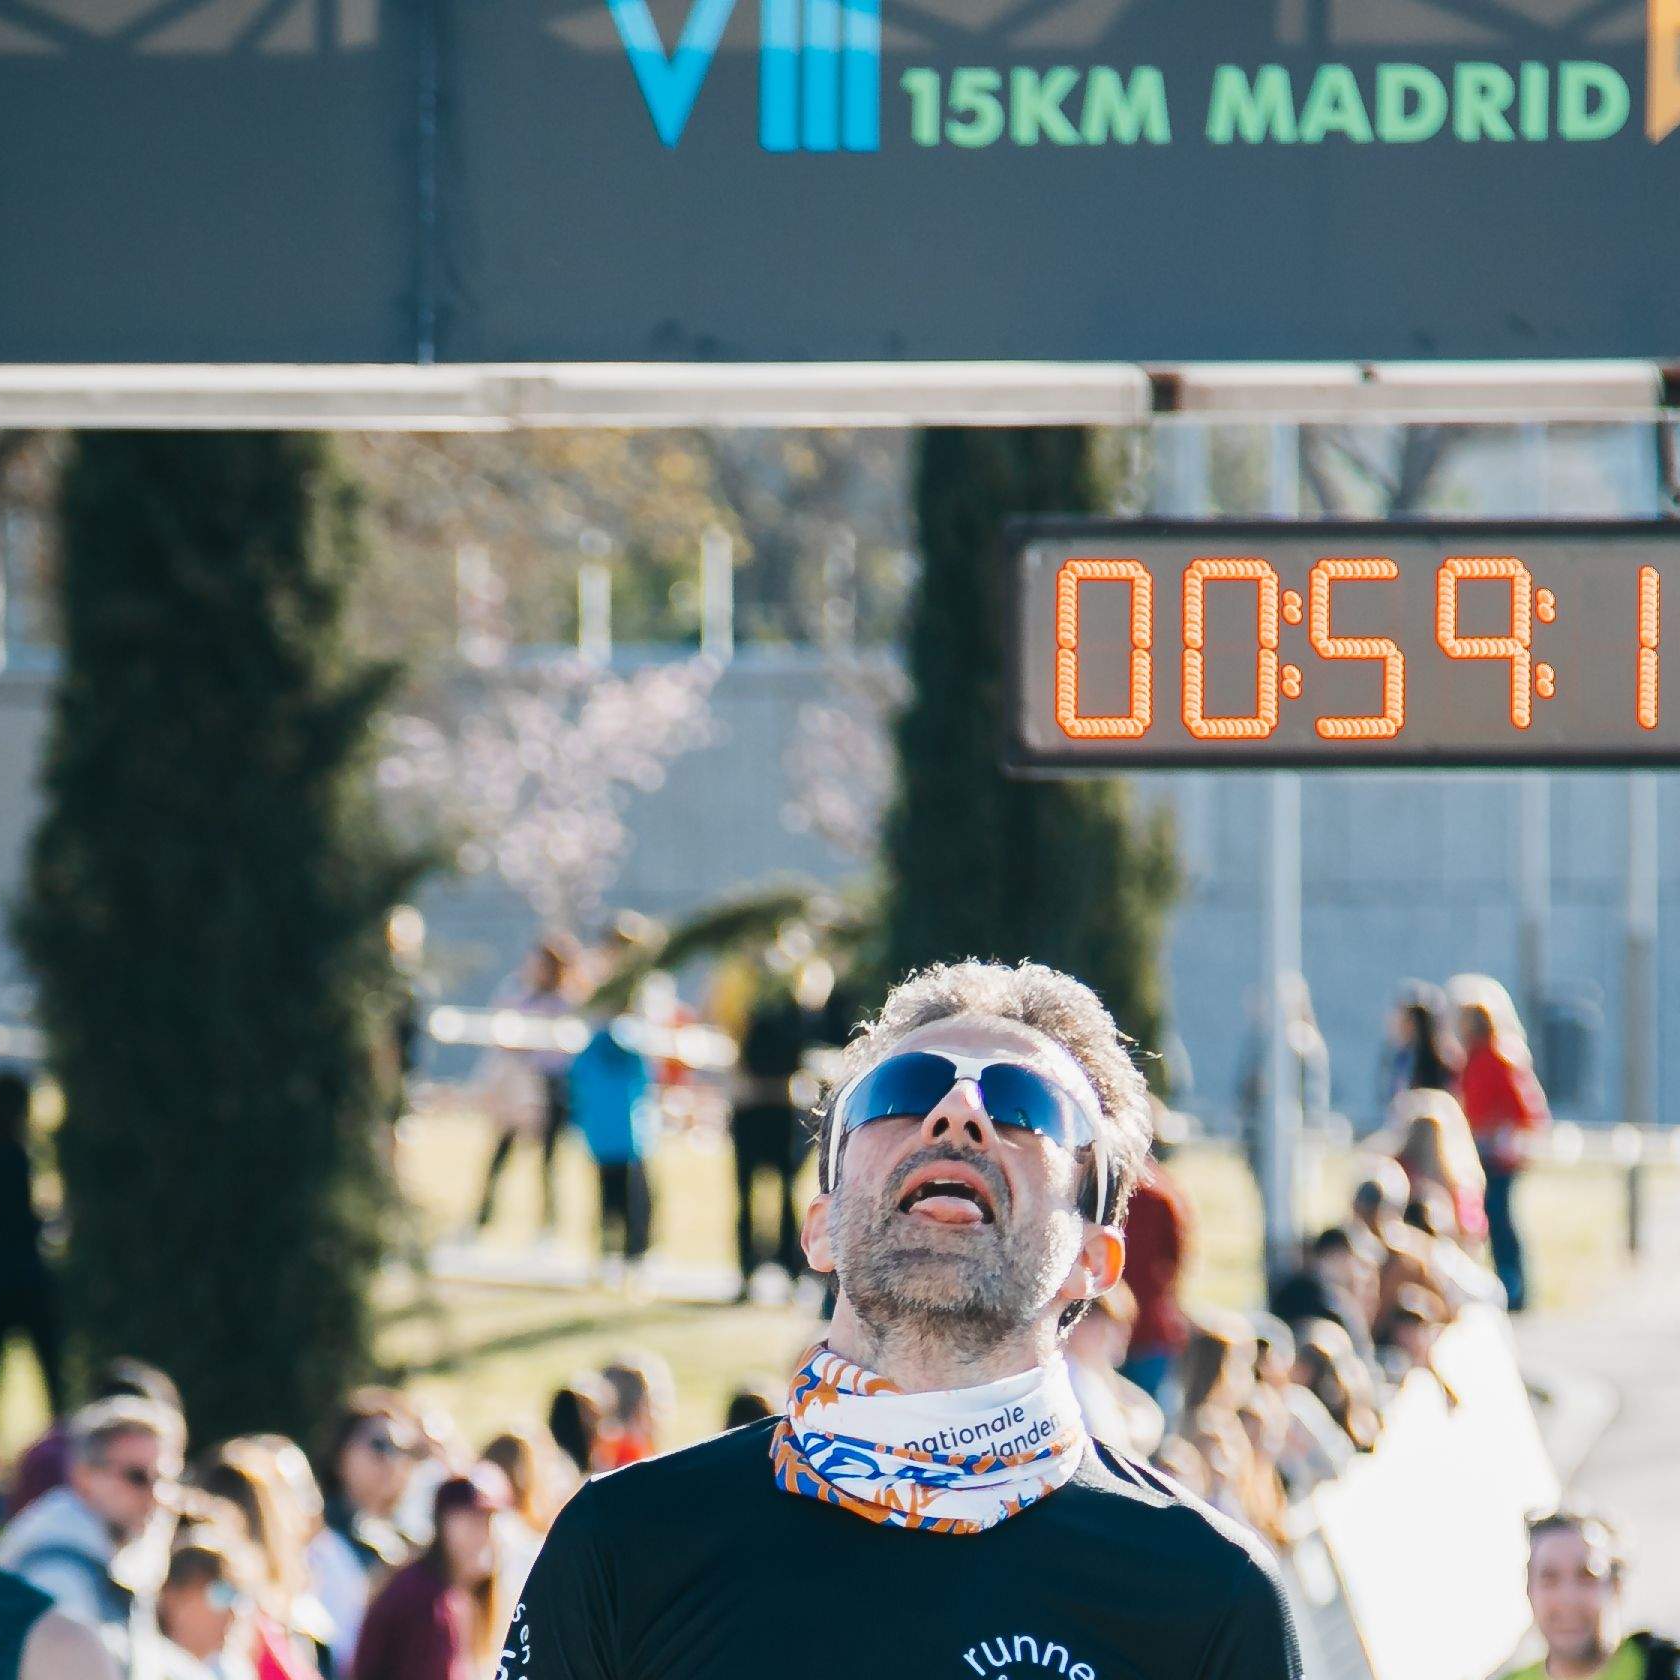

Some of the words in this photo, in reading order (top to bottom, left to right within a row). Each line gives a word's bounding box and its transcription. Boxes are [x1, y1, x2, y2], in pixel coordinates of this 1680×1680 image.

[902, 64, 1172, 146] 15KM
[1205, 58, 1631, 144] MADRID
[904, 1404, 1026, 1453] nationale
